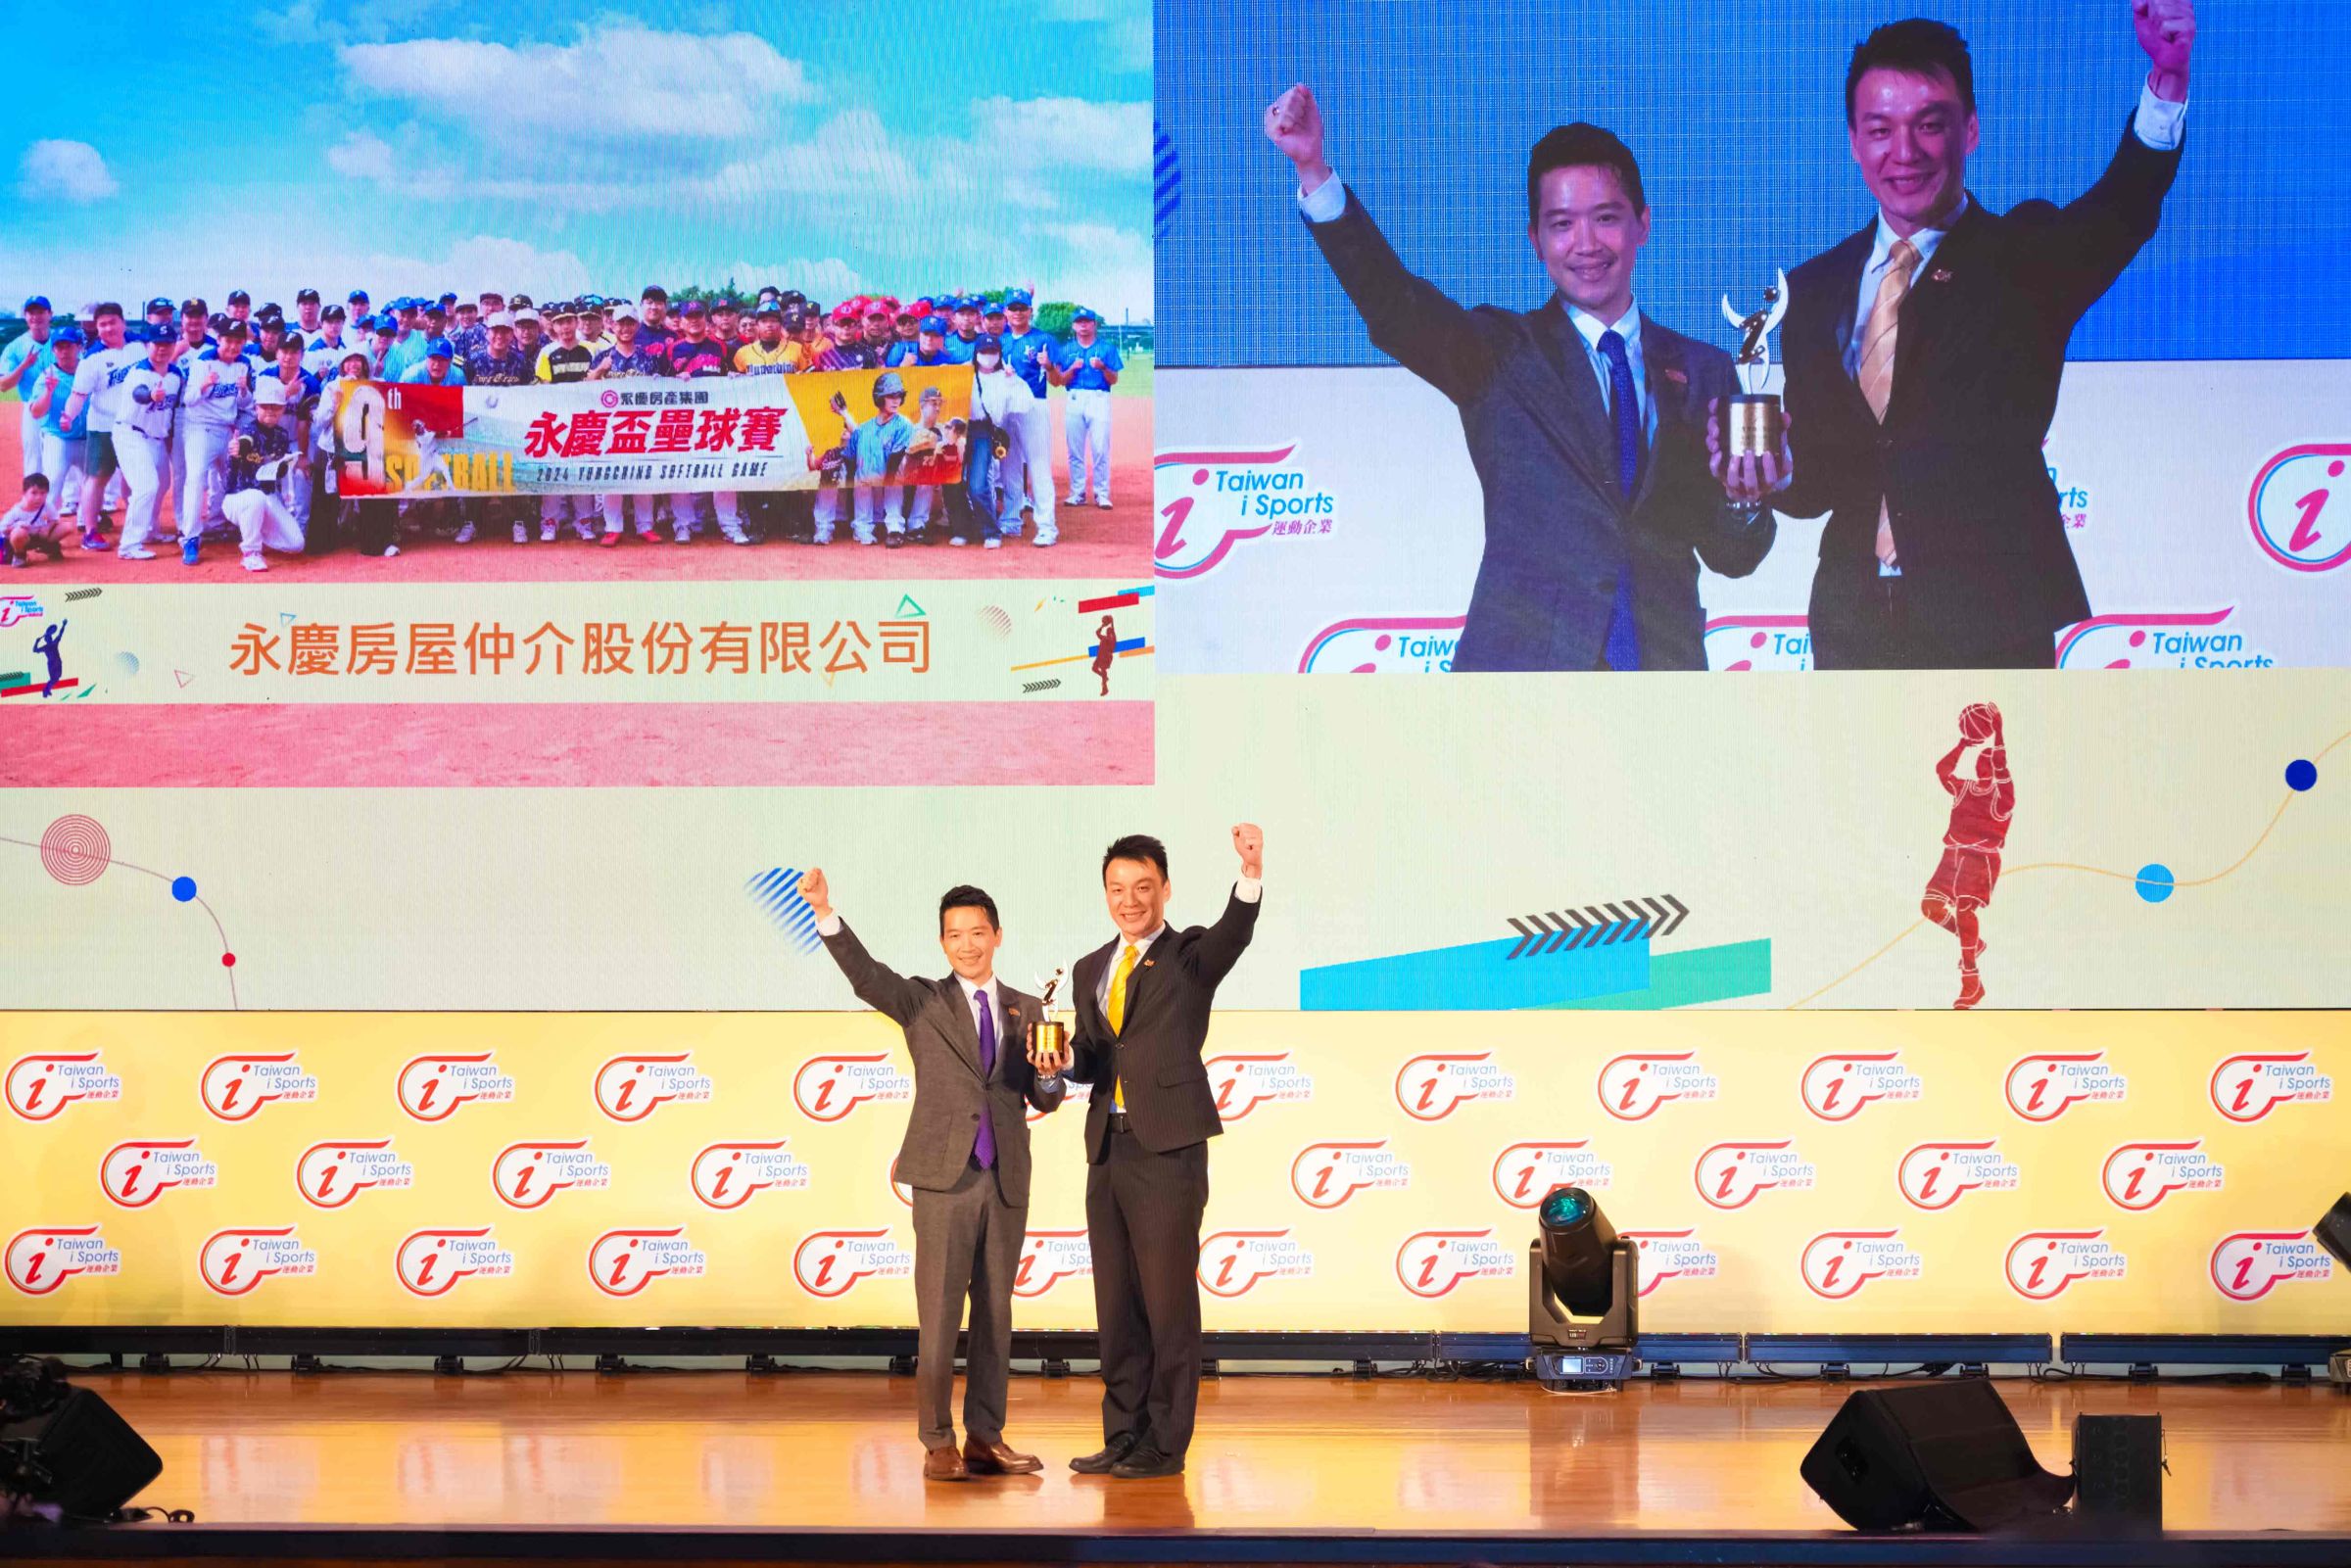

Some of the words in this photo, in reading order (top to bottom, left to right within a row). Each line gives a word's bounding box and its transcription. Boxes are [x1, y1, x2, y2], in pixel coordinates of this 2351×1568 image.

[524, 406, 788, 458] 永慶盃壘球賽
[537, 466, 569, 482] 2024
[659, 463, 724, 479] SOFTBALL
[732, 461, 769, 477] GAME
[1216, 470, 1304, 492] Taiwan
[2059, 487, 2087, 508] rts
[1241, 495, 1248, 516] i
[1255, 492, 1334, 520] Sports
[2289, 459, 2345, 552] i
[1155, 468, 1209, 559] i
[1271, 519, 1333, 536] 運動企業
[228, 621, 930, 676] 永慶房屋仲介股份有限公司
[1399, 636, 1460, 658] Taiw
[1774, 633, 1810, 655] Tai
[2153, 632, 2242, 654] Taiwan
[58, 1064, 103, 1076] Taiwan
[255, 1065, 301, 1077] Taiwan
[451, 1065, 497, 1077] Taiwan
[648, 1066, 694, 1078] Taiwan
[847, 1066, 894, 1078] Taiwan
[1247, 1065, 1294, 1077] Taiwan
[1449, 1065, 1496, 1077] Taiwan
[1652, 1065, 1700, 1077] Taiwan
[1855, 1065, 1903, 1077] Taiwan
[2060, 1065, 2108, 1077] Taiwan
[2266, 1064, 2315, 1076] Taiwan
[77, 1076, 120, 1090] Sports
[274, 1077, 316, 1091] Sports
[470, 1077, 512, 1091] Sports
[667, 1078, 710, 1092] Sports
[815, 1066, 843, 1111] i
[867, 1078, 910, 1092] Sports
[1216, 1065, 1243, 1111] i
[1417, 1065, 1445, 1111] i
[1620, 1065, 1648, 1110] i
[1876, 1077, 1920, 1091] Sports
[2081, 1077, 2125, 1091] Sports
[2286, 1076, 2331, 1090] Sports
[154, 1151, 200, 1164] Taiwan
[350, 1152, 396, 1164] Taiwan
[547, 1152, 593, 1164] Taiwan
[744, 1153, 791, 1165] Taiwan
[1344, 1152, 1392, 1164] Taiwan
[1547, 1152, 1595, 1164] Taiwan
[1750, 1152, 1798, 1164] Taiwan
[1953, 1153, 2001, 1165] Taiwan
[2157, 1153, 2205, 1165] Taiwan
[173, 1164, 216, 1177] Sports
[369, 1164, 411, 1178] Sports
[566, 1164, 609, 1178] Sports
[764, 1165, 807, 1179] Sports
[1313, 1152, 1340, 1198] i
[1514, 1152, 1543, 1198] i
[1716, 1152, 1746, 1199] i
[1770, 1164, 1814, 1178] Sports
[1974, 1165, 2018, 1179] Sports
[2178, 1165, 2223, 1179] Sports
[58, 1238, 103, 1251] Taiwan
[254, 1238, 300, 1251] Taiwan
[450, 1239, 496, 1252] Taiwan
[642, 1239, 688, 1252] Taiwan
[847, 1240, 894, 1253] Taiwan
[1248, 1240, 1295, 1253] Taiwan
[1450, 1241, 1497, 1254] Taiwan
[1652, 1241, 1700, 1254] Taiwan
[1854, 1241, 1902, 1254] Taiwan
[2061, 1242, 2109, 1255] Taiwan
[2266, 1242, 2315, 1255] Taiwan
[77, 1251, 120, 1264] Sports
[273, 1251, 315, 1264] Sports
[469, 1252, 511, 1265] Sports
[661, 1252, 704, 1265] Sports
[815, 1240, 843, 1287] i
[867, 1253, 910, 1266] Sports
[1014, 1241, 1043, 1286] i
[1069, 1254, 1092, 1266] Spo
[1217, 1240, 1244, 1287] i
[1417, 1241, 1446, 1287] i
[1672, 1254, 1716, 1267] Sports
[1875, 1254, 1919, 1267] Sports
[2082, 1255, 2126, 1268] Sports
[2286, 1255, 2331, 1268] Sports
